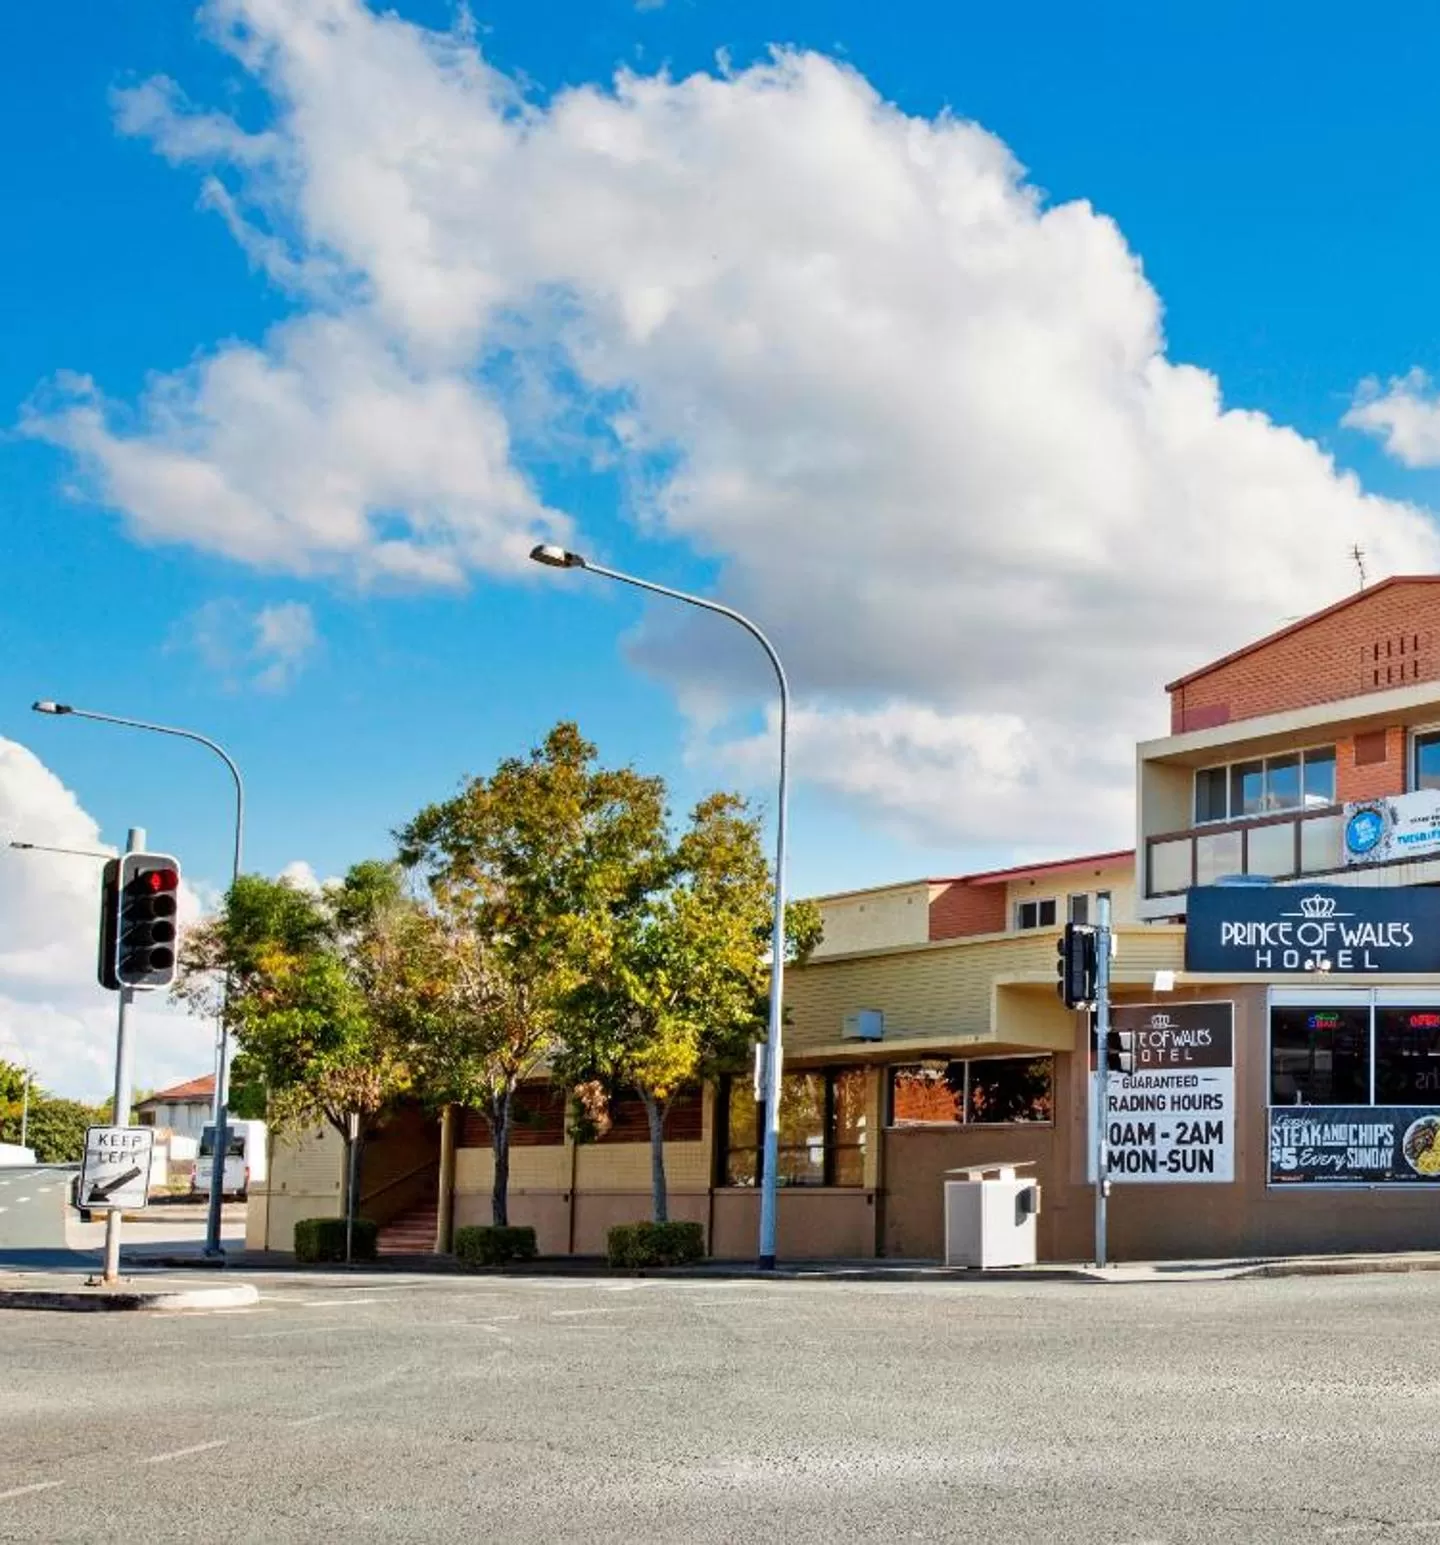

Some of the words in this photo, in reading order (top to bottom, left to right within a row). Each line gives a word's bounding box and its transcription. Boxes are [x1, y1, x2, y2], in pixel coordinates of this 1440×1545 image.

[1221, 922, 1292, 946] PRINCE
[1297, 922, 1336, 946] OF
[1340, 922, 1413, 947] WALES
[1255, 950, 1379, 969] HOTEL
[1150, 1031, 1170, 1048] OF
[1172, 1028, 1212, 1047] WALES
[1141, 1049, 1193, 1063] OTEL
[1122, 1075, 1199, 1089] GUARANTEED
[1108, 1095, 1166, 1112] RADING
[1171, 1094, 1224, 1111] HOURS
[98, 1133, 142, 1148] KEEP
[1109, 1122, 1156, 1146] 0AM
[1175, 1121, 1224, 1146] 2AM
[1271, 1124, 1322, 1146] STEAK
[1322, 1124, 1347, 1146] AND
[1348, 1124, 1394, 1146] CHIPS
[99, 1151, 139, 1164] LEFT
[1107, 1149, 1214, 1173] MON-SUN
[1271, 1148, 1299, 1170] $5
[1300, 1148, 1346, 1172] Every
[1347, 1147, 1394, 1169] SUNDAY
